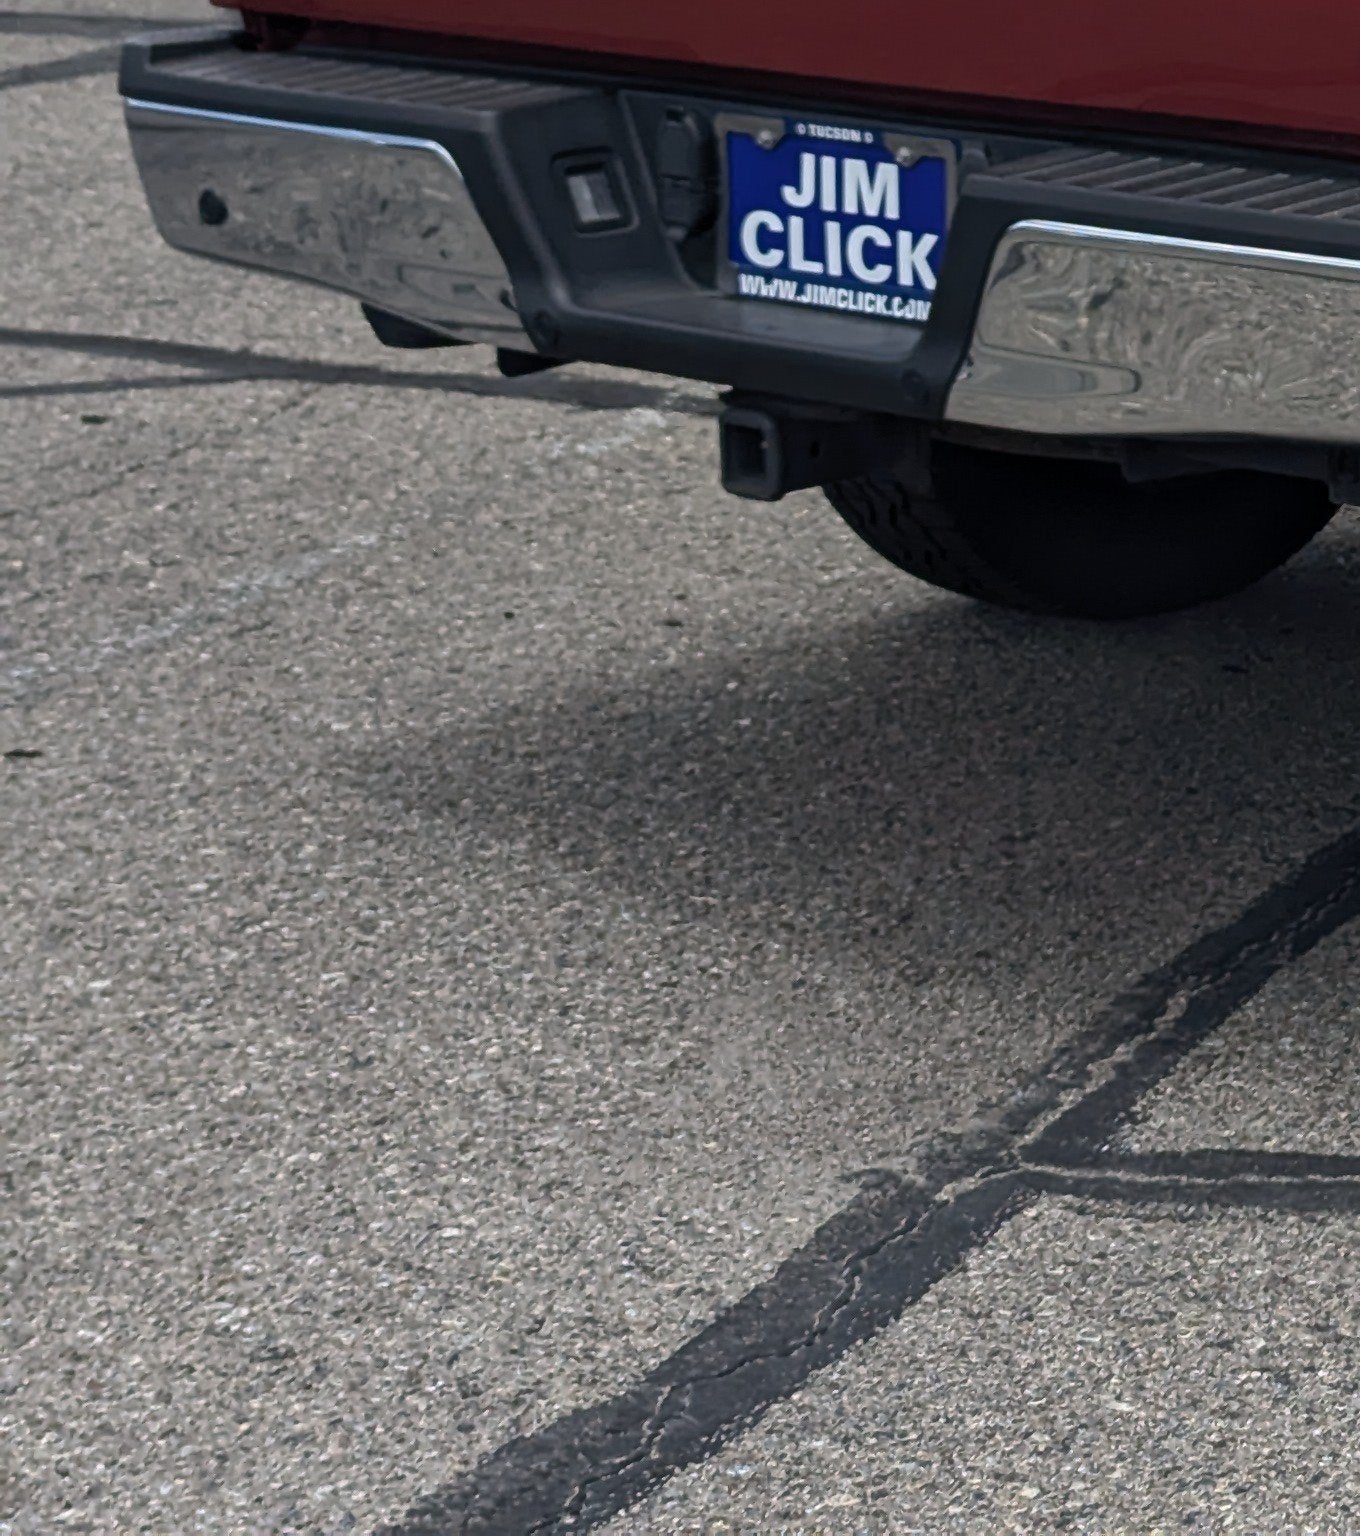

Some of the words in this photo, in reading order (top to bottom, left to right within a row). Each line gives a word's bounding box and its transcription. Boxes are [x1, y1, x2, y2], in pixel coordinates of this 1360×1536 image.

[808, 123, 862, 143] TUCSON
[780, 151, 900, 220] JIM
[740, 210, 939, 291] CLICK
